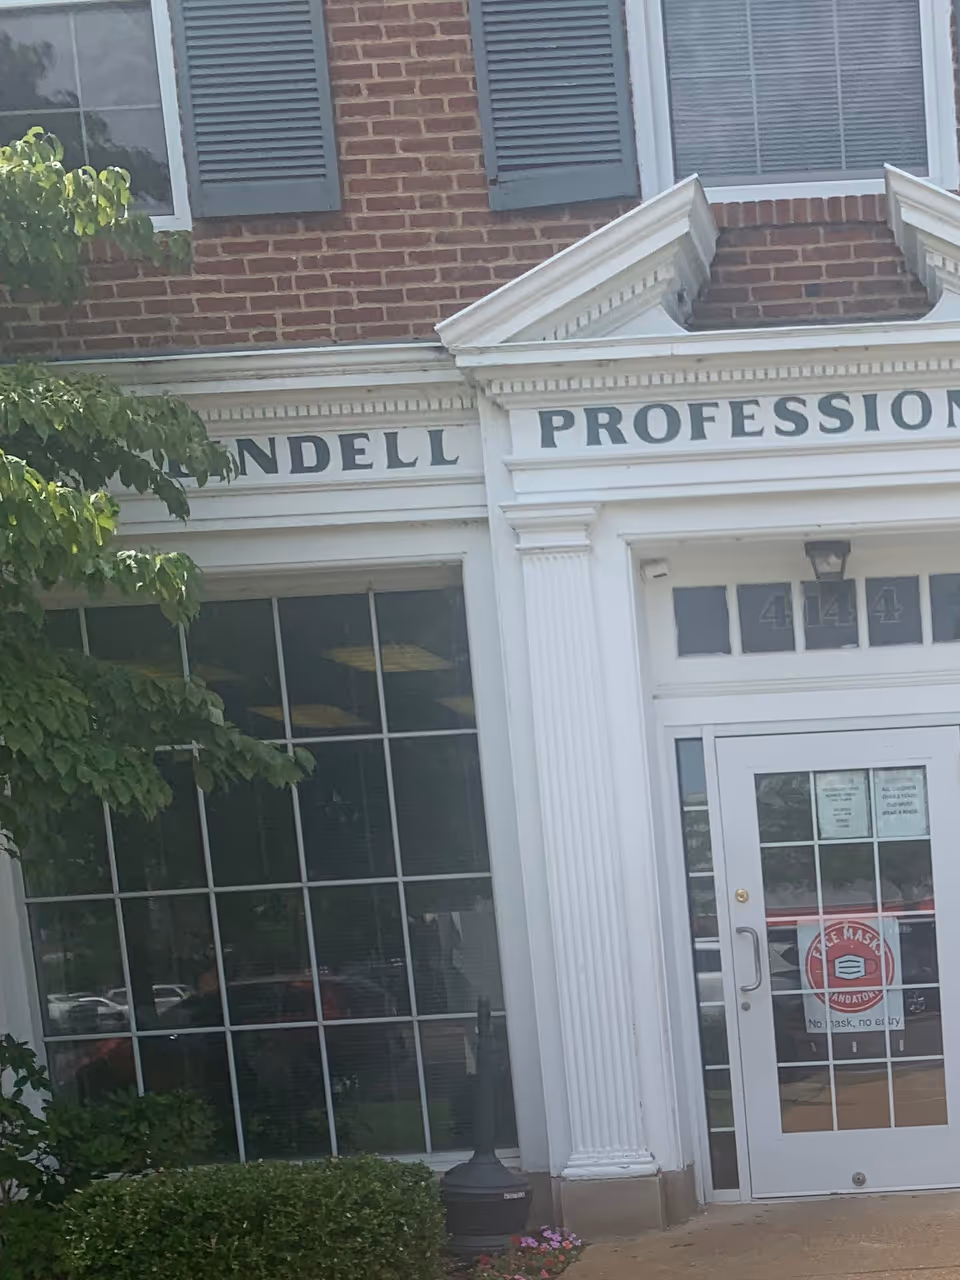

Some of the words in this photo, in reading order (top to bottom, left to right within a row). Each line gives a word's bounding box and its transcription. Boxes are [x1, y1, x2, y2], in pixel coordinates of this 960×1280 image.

[168, 428, 460, 478] NDELL
[828, 990, 880, 1005] ANDATOR
[808, 1018, 822, 1029] No
[858, 1018, 872, 1028] no
